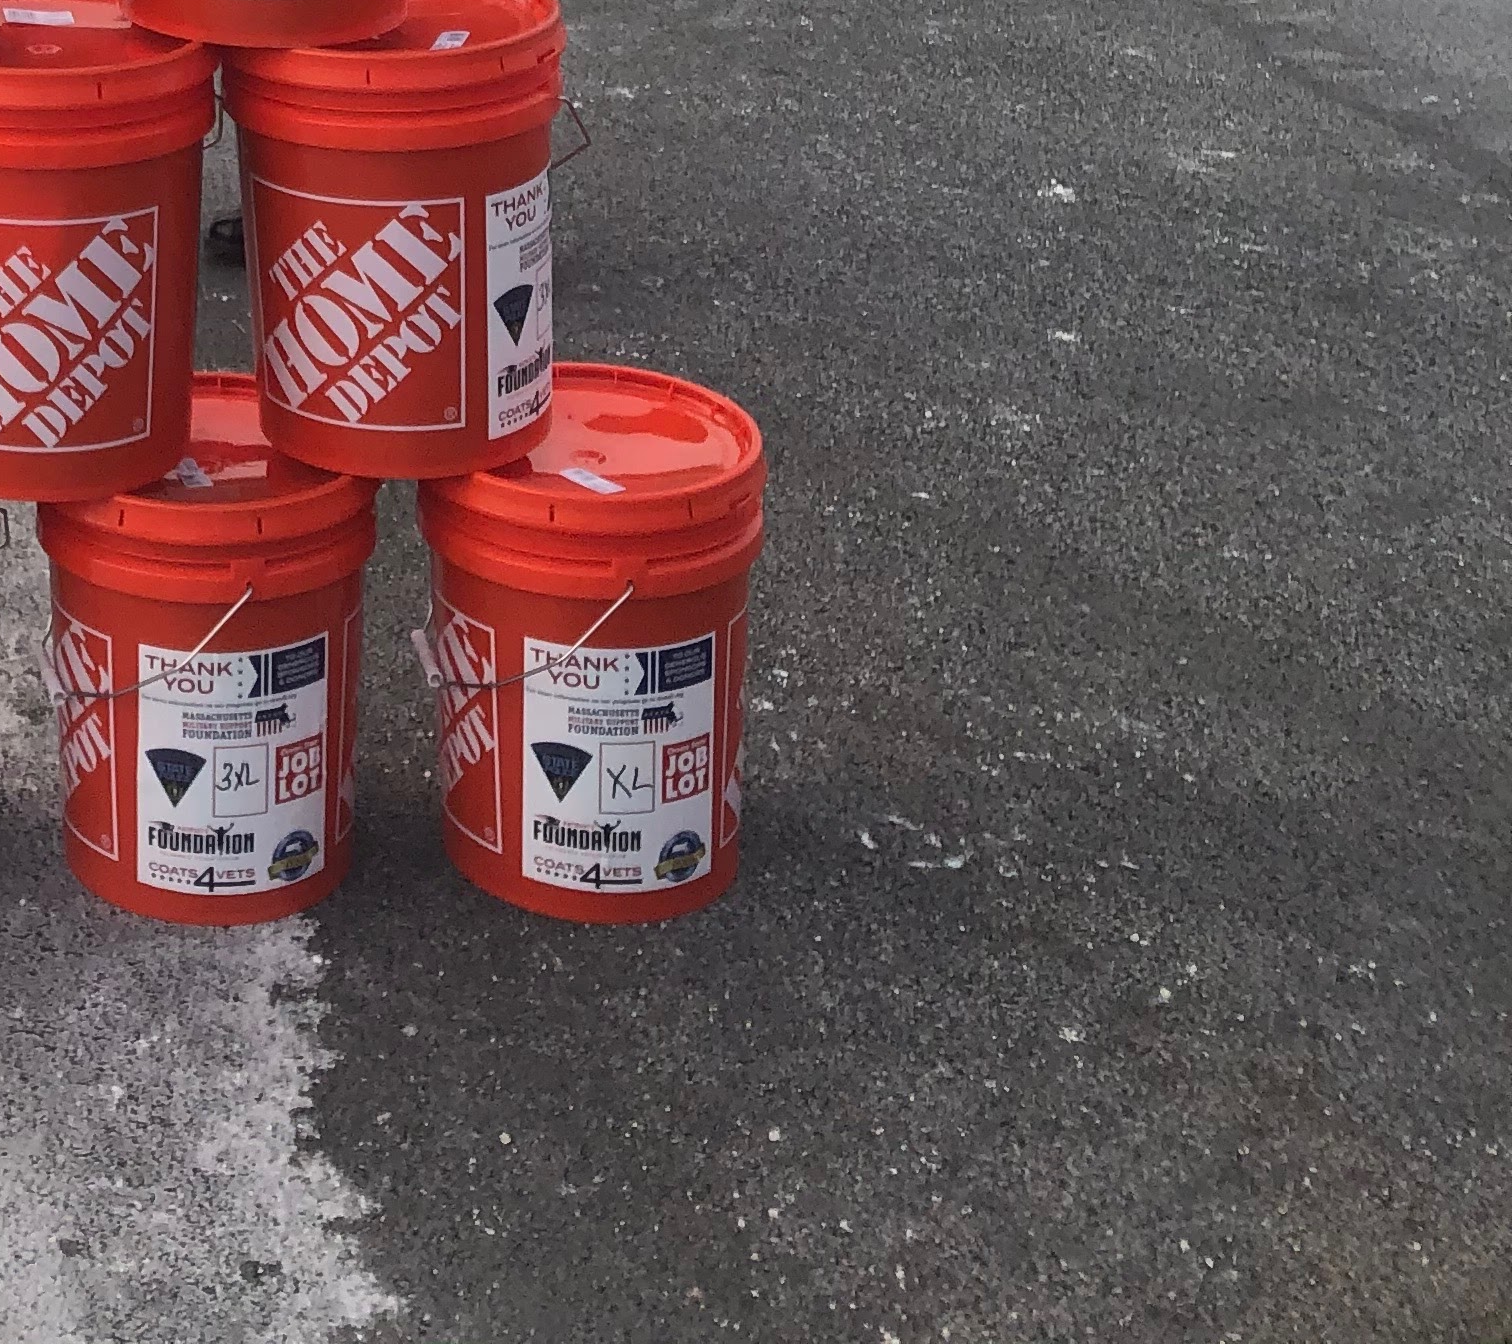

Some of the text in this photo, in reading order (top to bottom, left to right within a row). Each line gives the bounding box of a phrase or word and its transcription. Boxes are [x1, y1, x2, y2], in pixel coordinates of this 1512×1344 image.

[491, 182, 543, 217] THANK
[505, 205, 536, 231] YOU
[269, 220, 347, 301] THE
[263, 203, 462, 410] HOME
[324, 284, 463, 424] DEPOT
[22, 299, 151, 449] DEPOT
[145, 655, 233, 676] THANK
[530, 647, 620, 672] THANK
[163, 676, 214, 694] YOU
[547, 669, 600, 689] YOU
[215, 762, 260, 792] 3XL
[279, 745, 320, 778] JOB
[665, 746, 707, 777] JOB
[279, 767, 320, 799] LOT
[606, 765, 654, 799] XL
[665, 768, 707, 800] LOT
